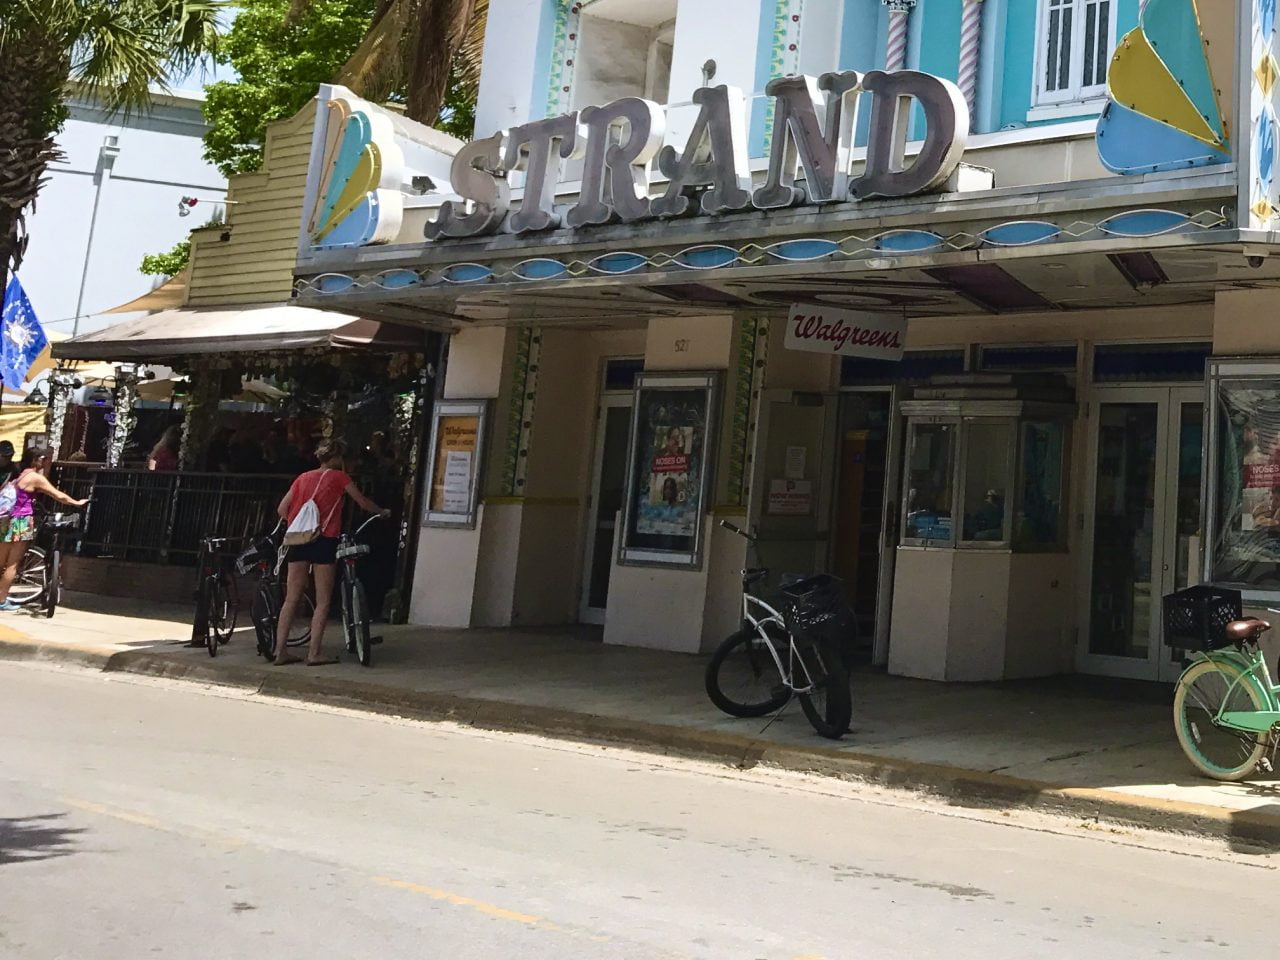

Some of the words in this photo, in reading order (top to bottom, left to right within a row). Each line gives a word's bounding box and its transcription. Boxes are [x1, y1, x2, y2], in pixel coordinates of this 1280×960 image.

[423, 69, 970, 240] STRAND
[793, 314, 901, 351] Walgreens
[1252, 464, 1279, 474] NOSES
